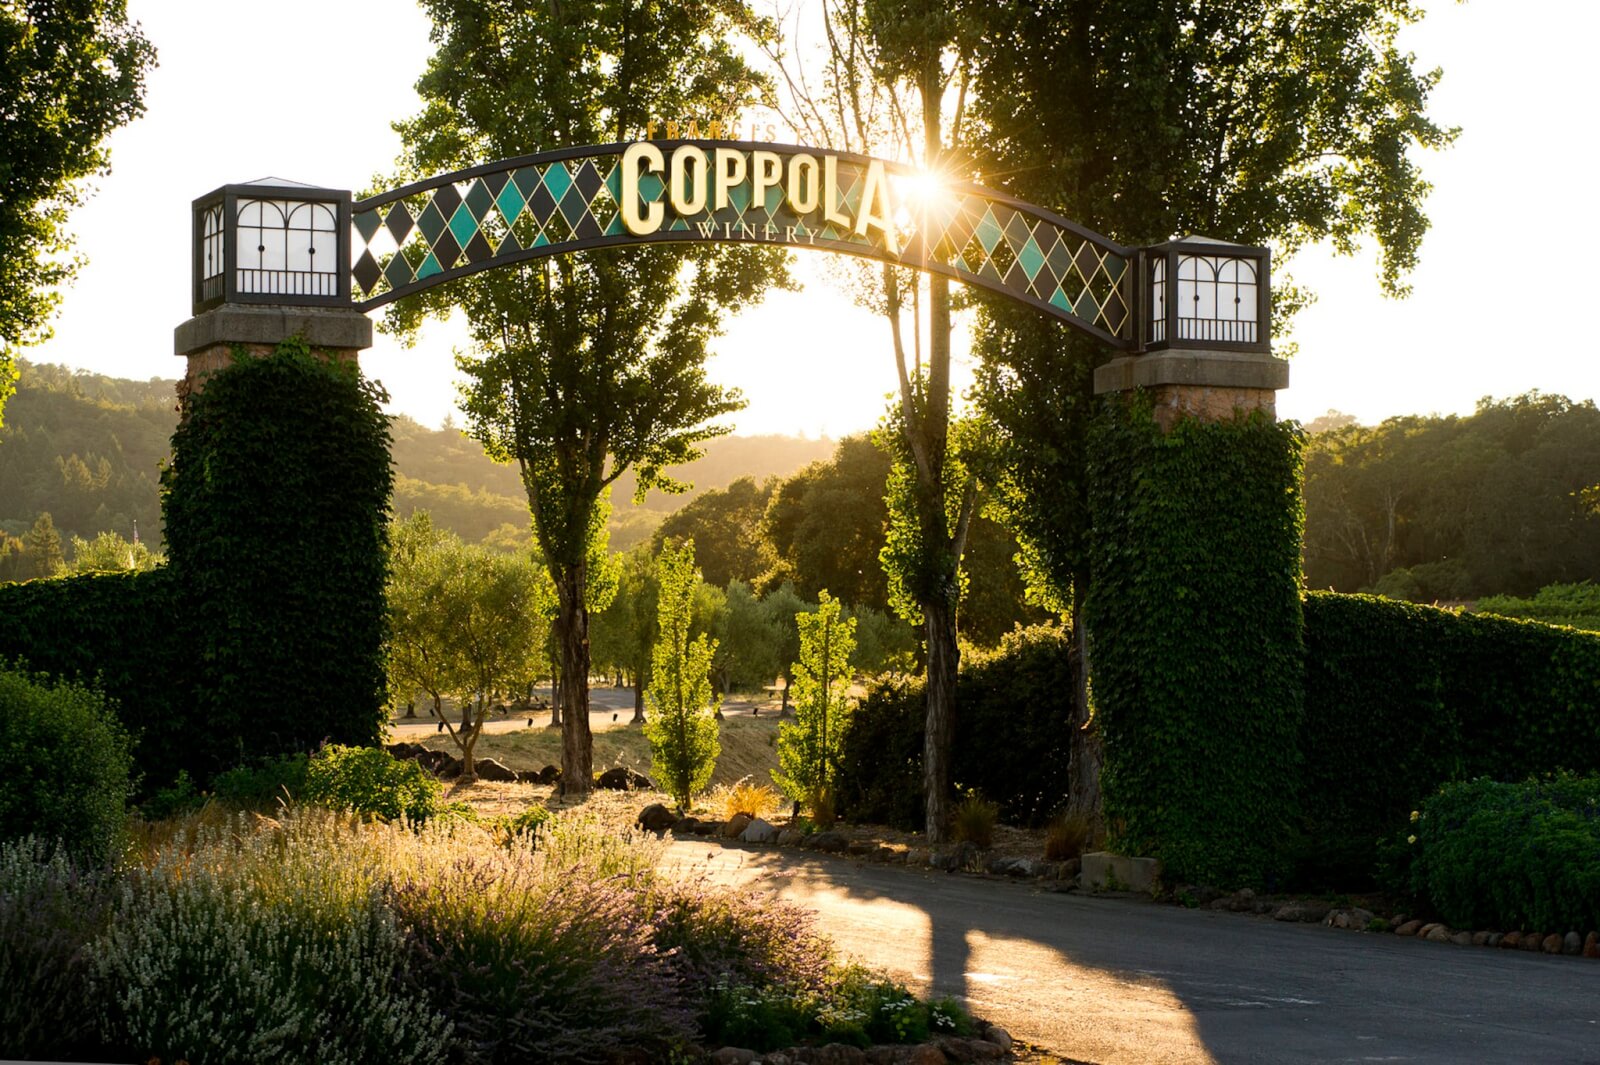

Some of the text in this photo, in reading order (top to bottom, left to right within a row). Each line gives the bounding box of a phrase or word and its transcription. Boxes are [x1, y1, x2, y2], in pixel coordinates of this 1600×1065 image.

[648, 120, 776, 142] FRANCIS
[621, 141, 899, 257] COPPOLA
[696, 221, 819, 245] WINERY
